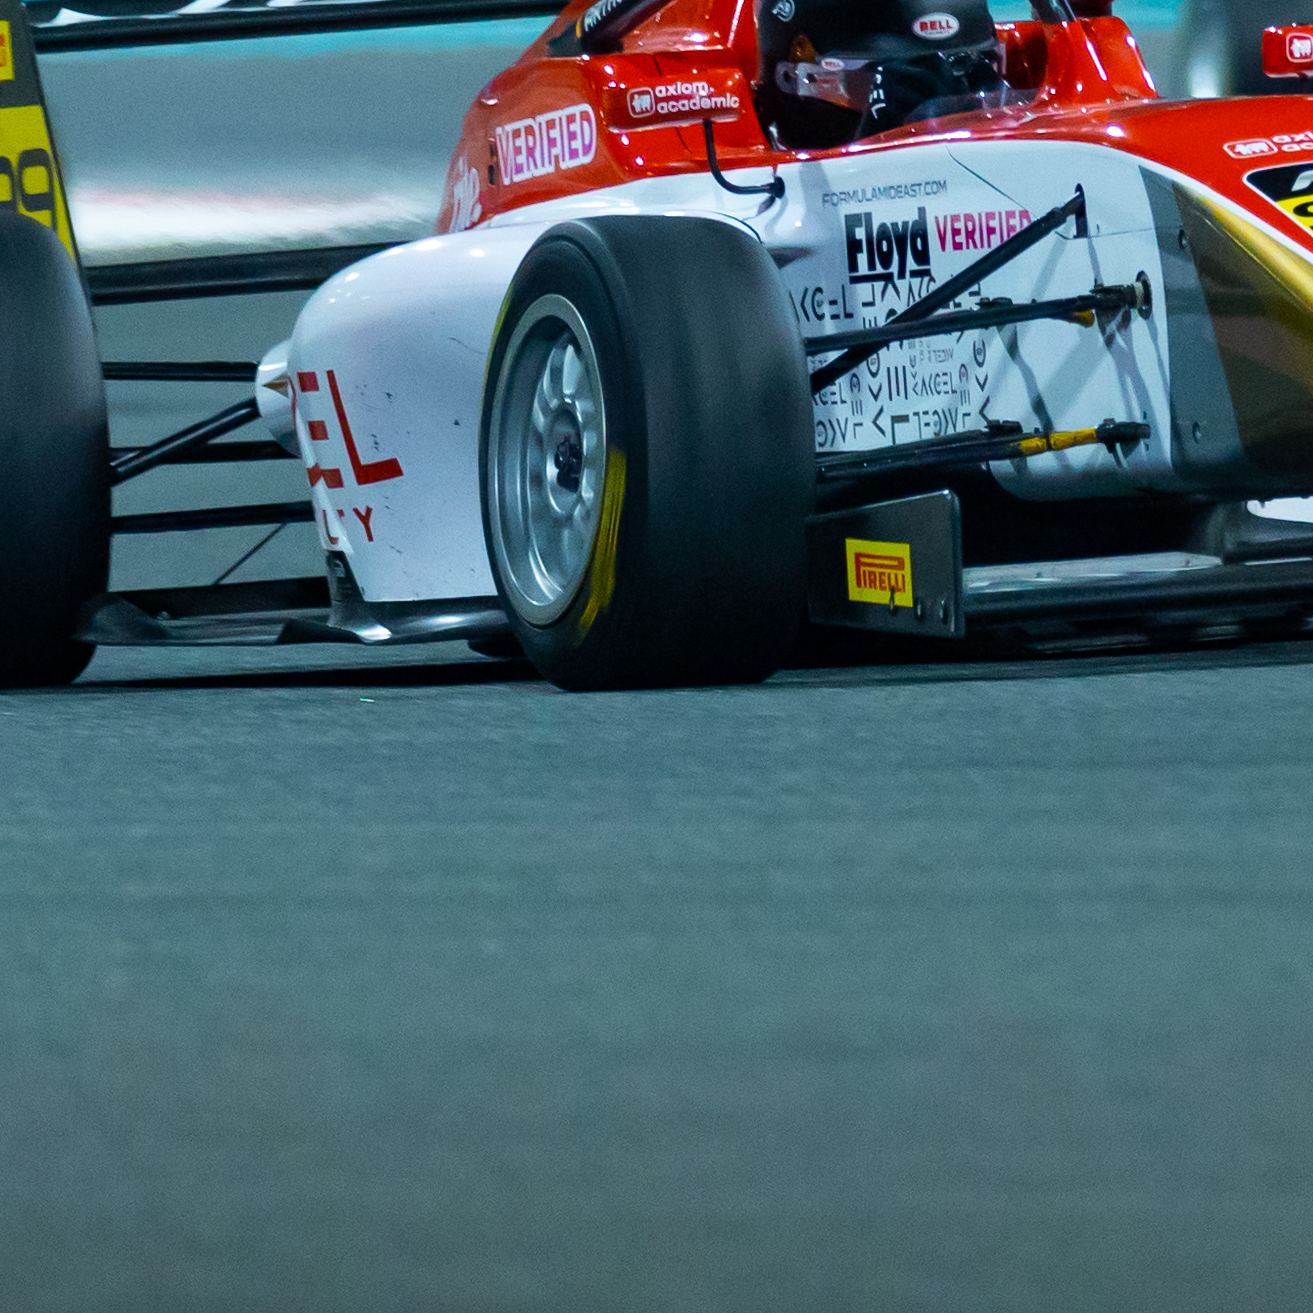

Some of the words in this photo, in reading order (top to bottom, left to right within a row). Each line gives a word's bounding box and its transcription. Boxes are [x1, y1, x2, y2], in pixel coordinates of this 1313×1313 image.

[919, 19, 953, 32] BELL
[656, 92, 740, 115] academic
[495, 103, 597, 186] VERIFIED
[844, 206, 931, 281] Floyd
[854, 551, 906, 594] PIRELLI
